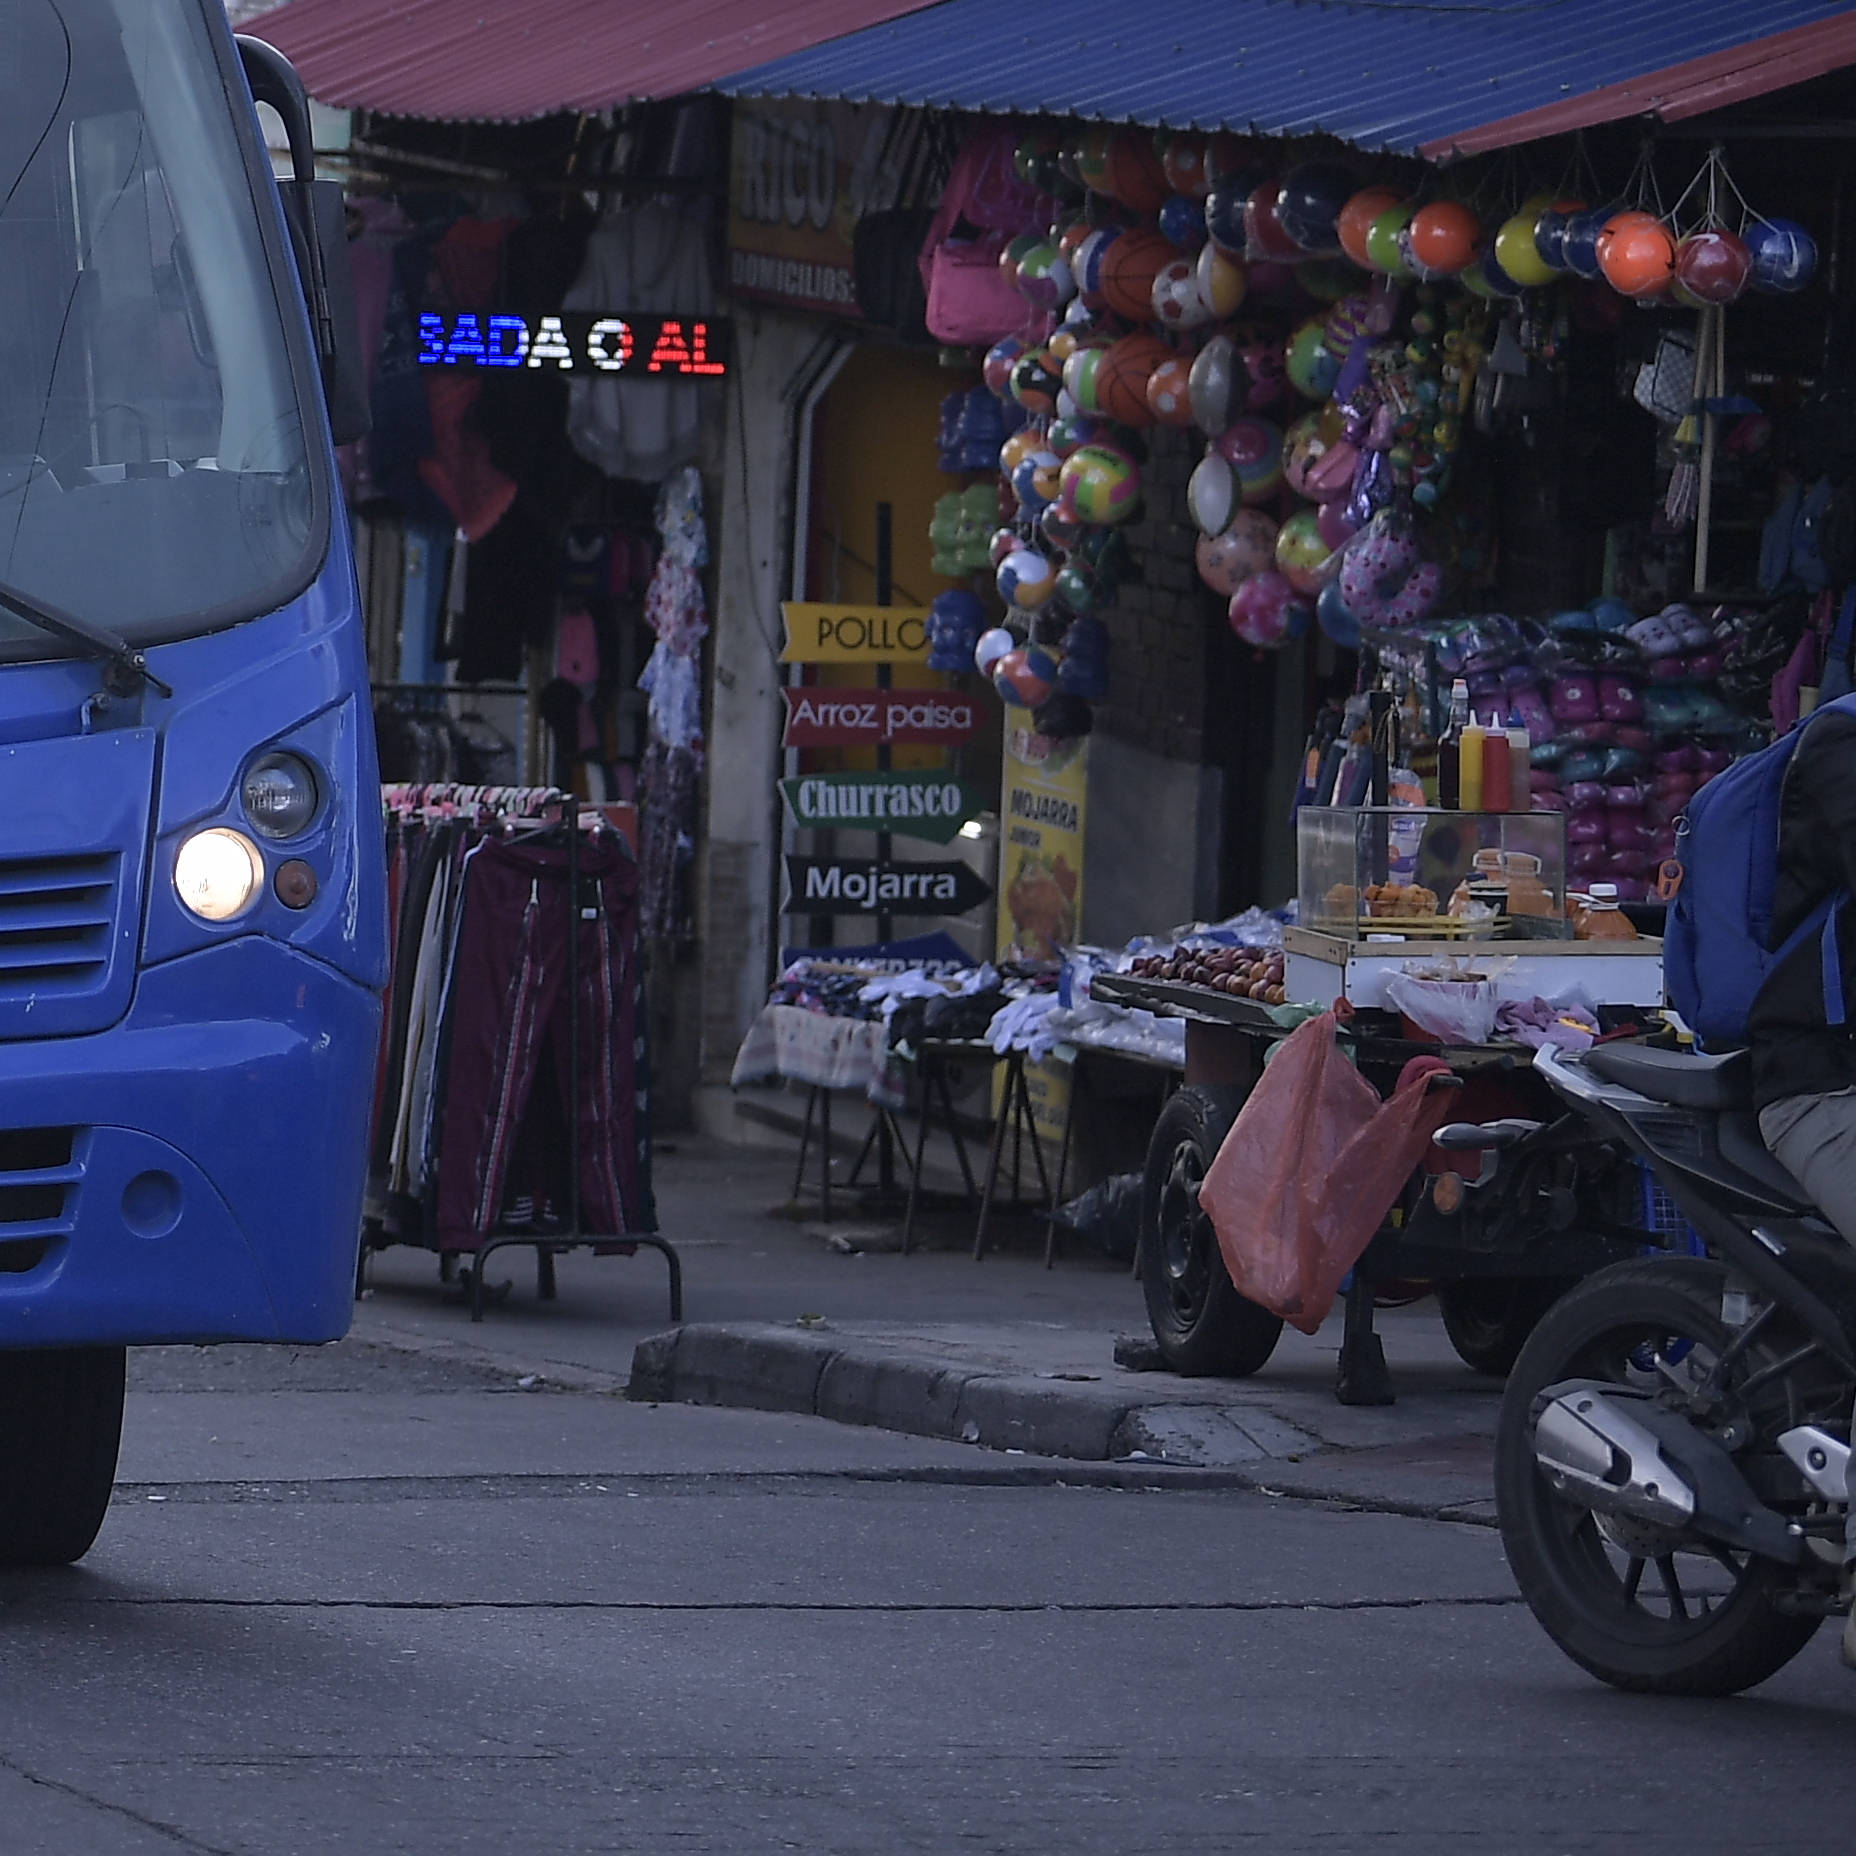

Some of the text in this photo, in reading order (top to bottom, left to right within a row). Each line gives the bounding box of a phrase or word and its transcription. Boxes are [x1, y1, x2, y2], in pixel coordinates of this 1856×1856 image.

[647, 320, 725, 375] AL
[819, 616, 928, 650] POLLO
[792, 700, 972, 737] Arroz paisa
[799, 779, 962, 818] Churrasco
[1010, 787, 1079, 834] MOJARRA
[805, 865, 957, 908] Mojarra
